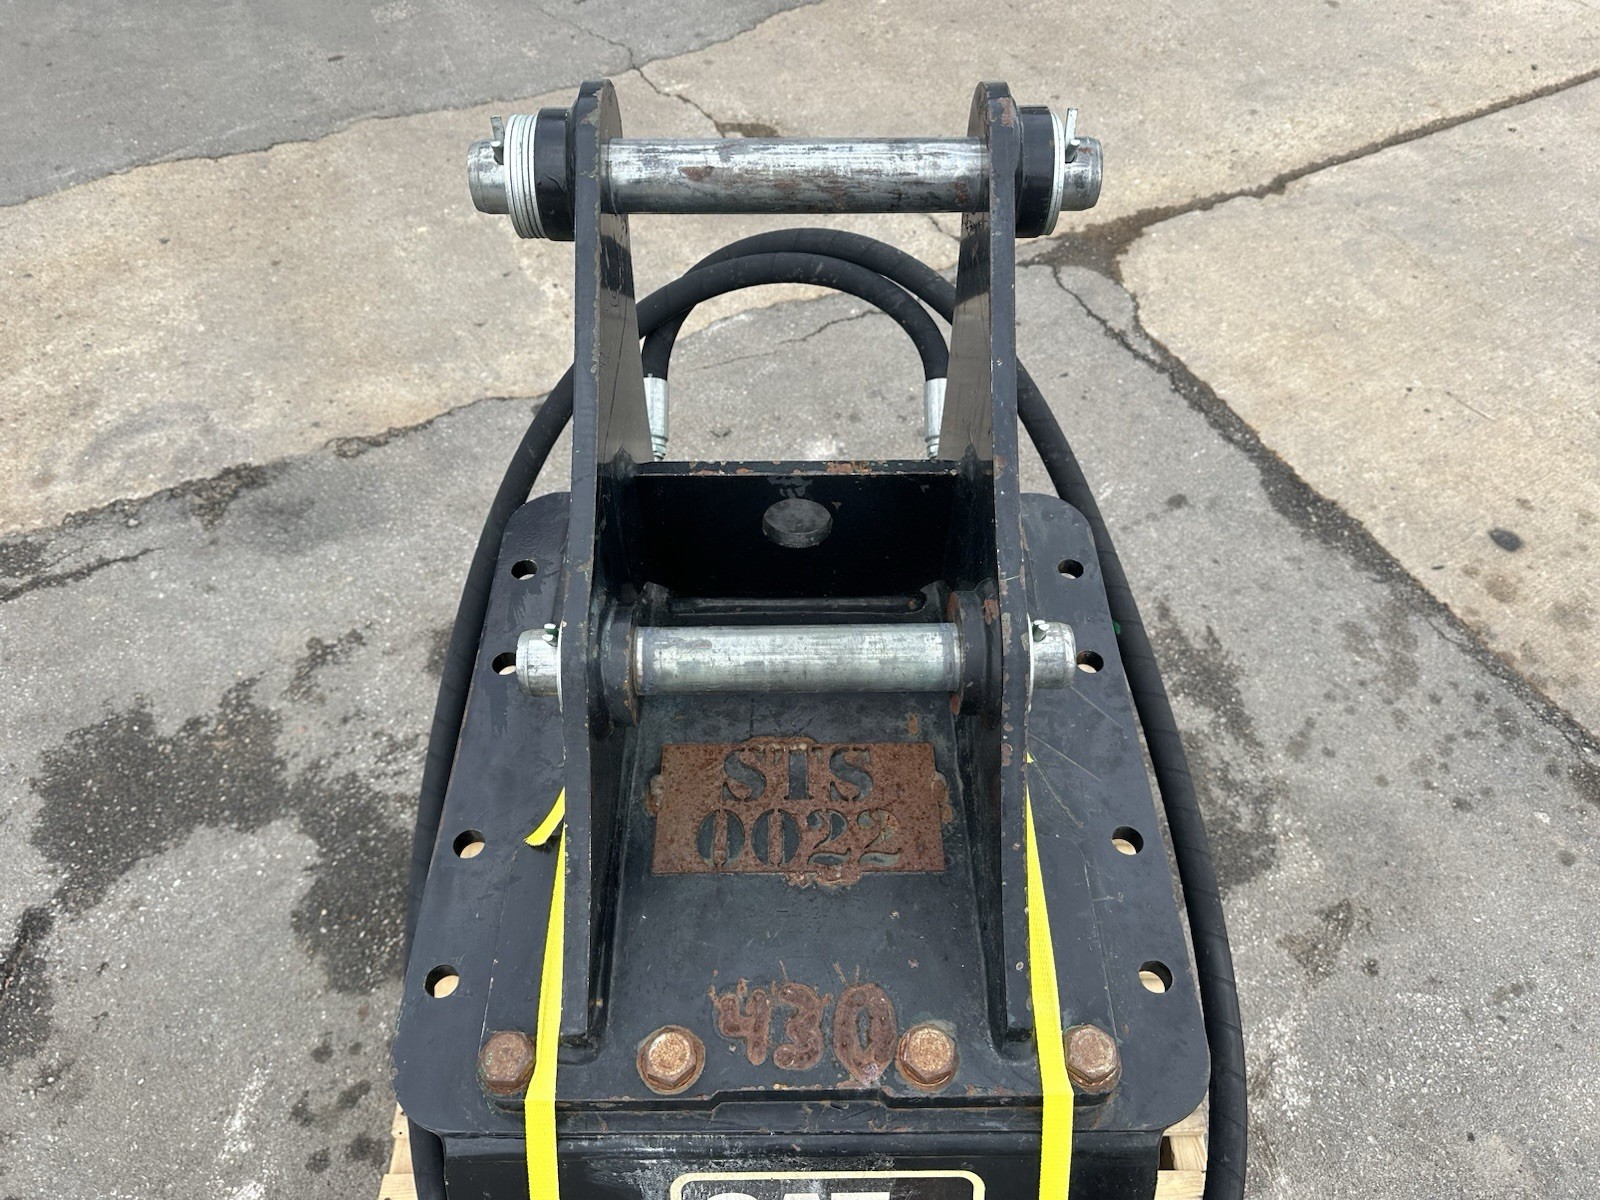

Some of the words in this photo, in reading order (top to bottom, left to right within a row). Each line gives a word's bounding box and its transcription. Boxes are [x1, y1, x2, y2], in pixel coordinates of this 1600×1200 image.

[722, 746, 874, 802] STS
[696, 808, 902, 868] 0022
[715, 983, 898, 1084] 430
